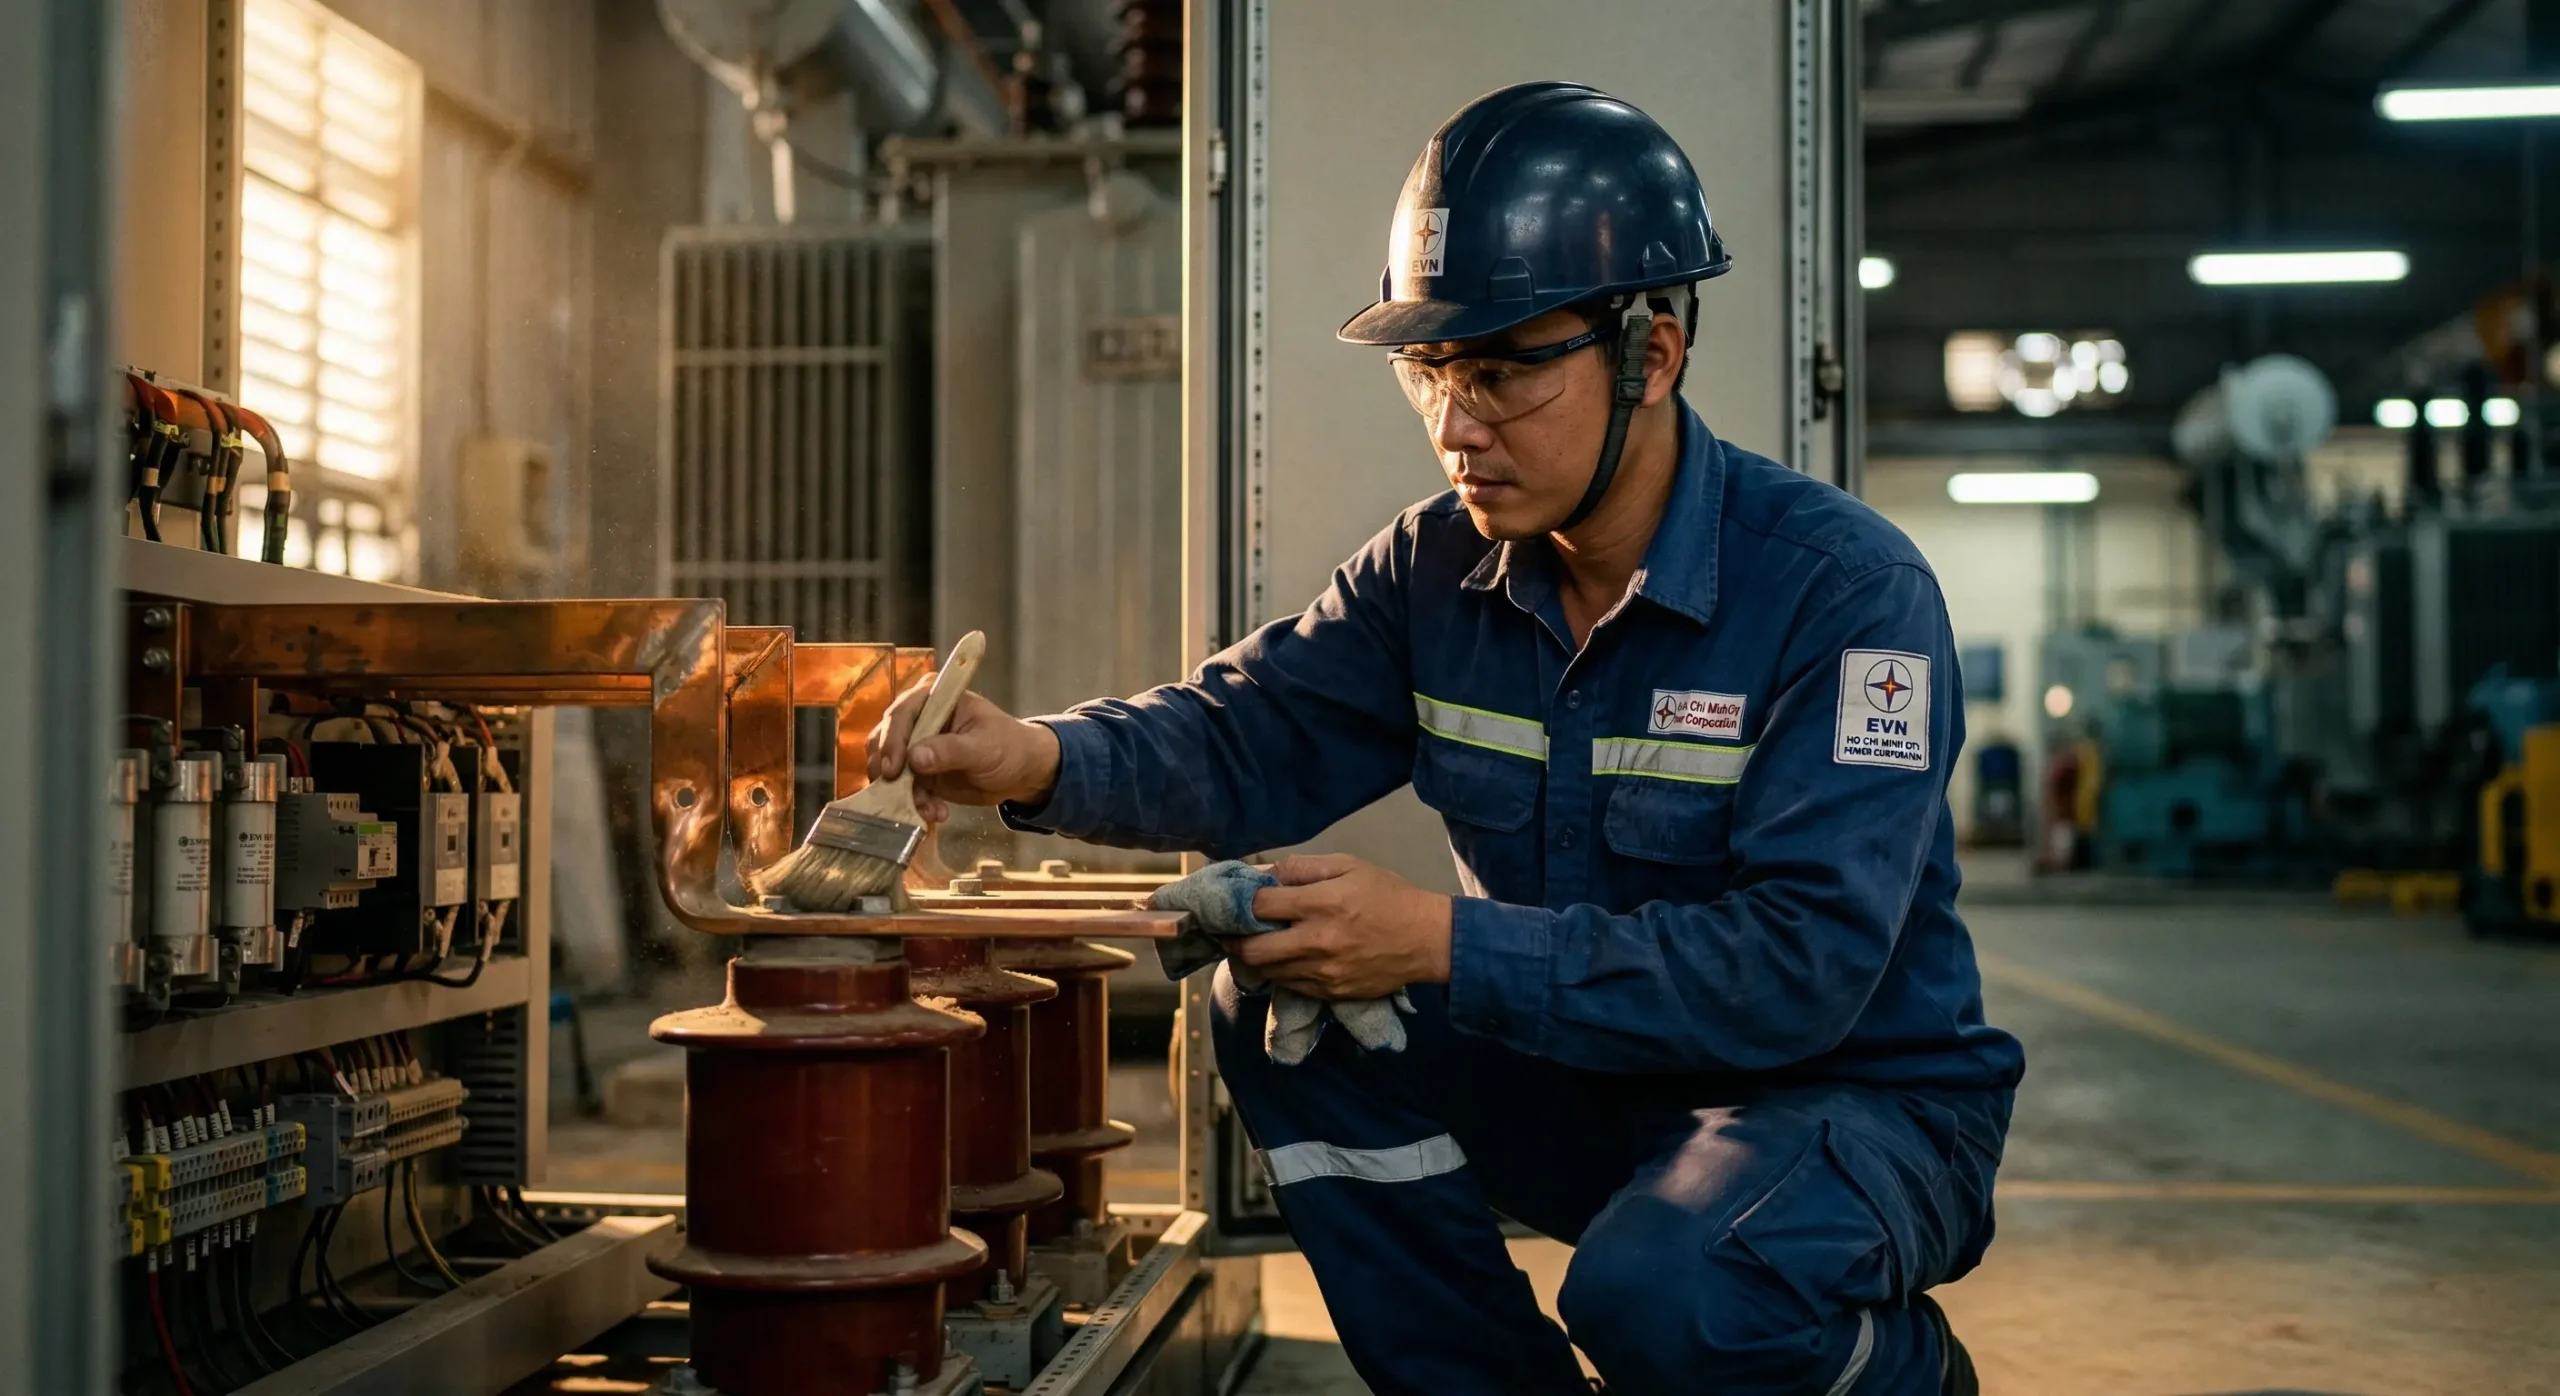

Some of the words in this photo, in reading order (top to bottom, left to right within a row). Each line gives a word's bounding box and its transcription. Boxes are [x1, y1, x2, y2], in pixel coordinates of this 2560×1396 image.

[1412, 259, 1439, 273] EVN
[1866, 717, 1908, 736] EVN
[1846, 736, 1861, 744] HO
[1863, 737, 1879, 746] CHI
[1881, 738, 1903, 749] MINH
